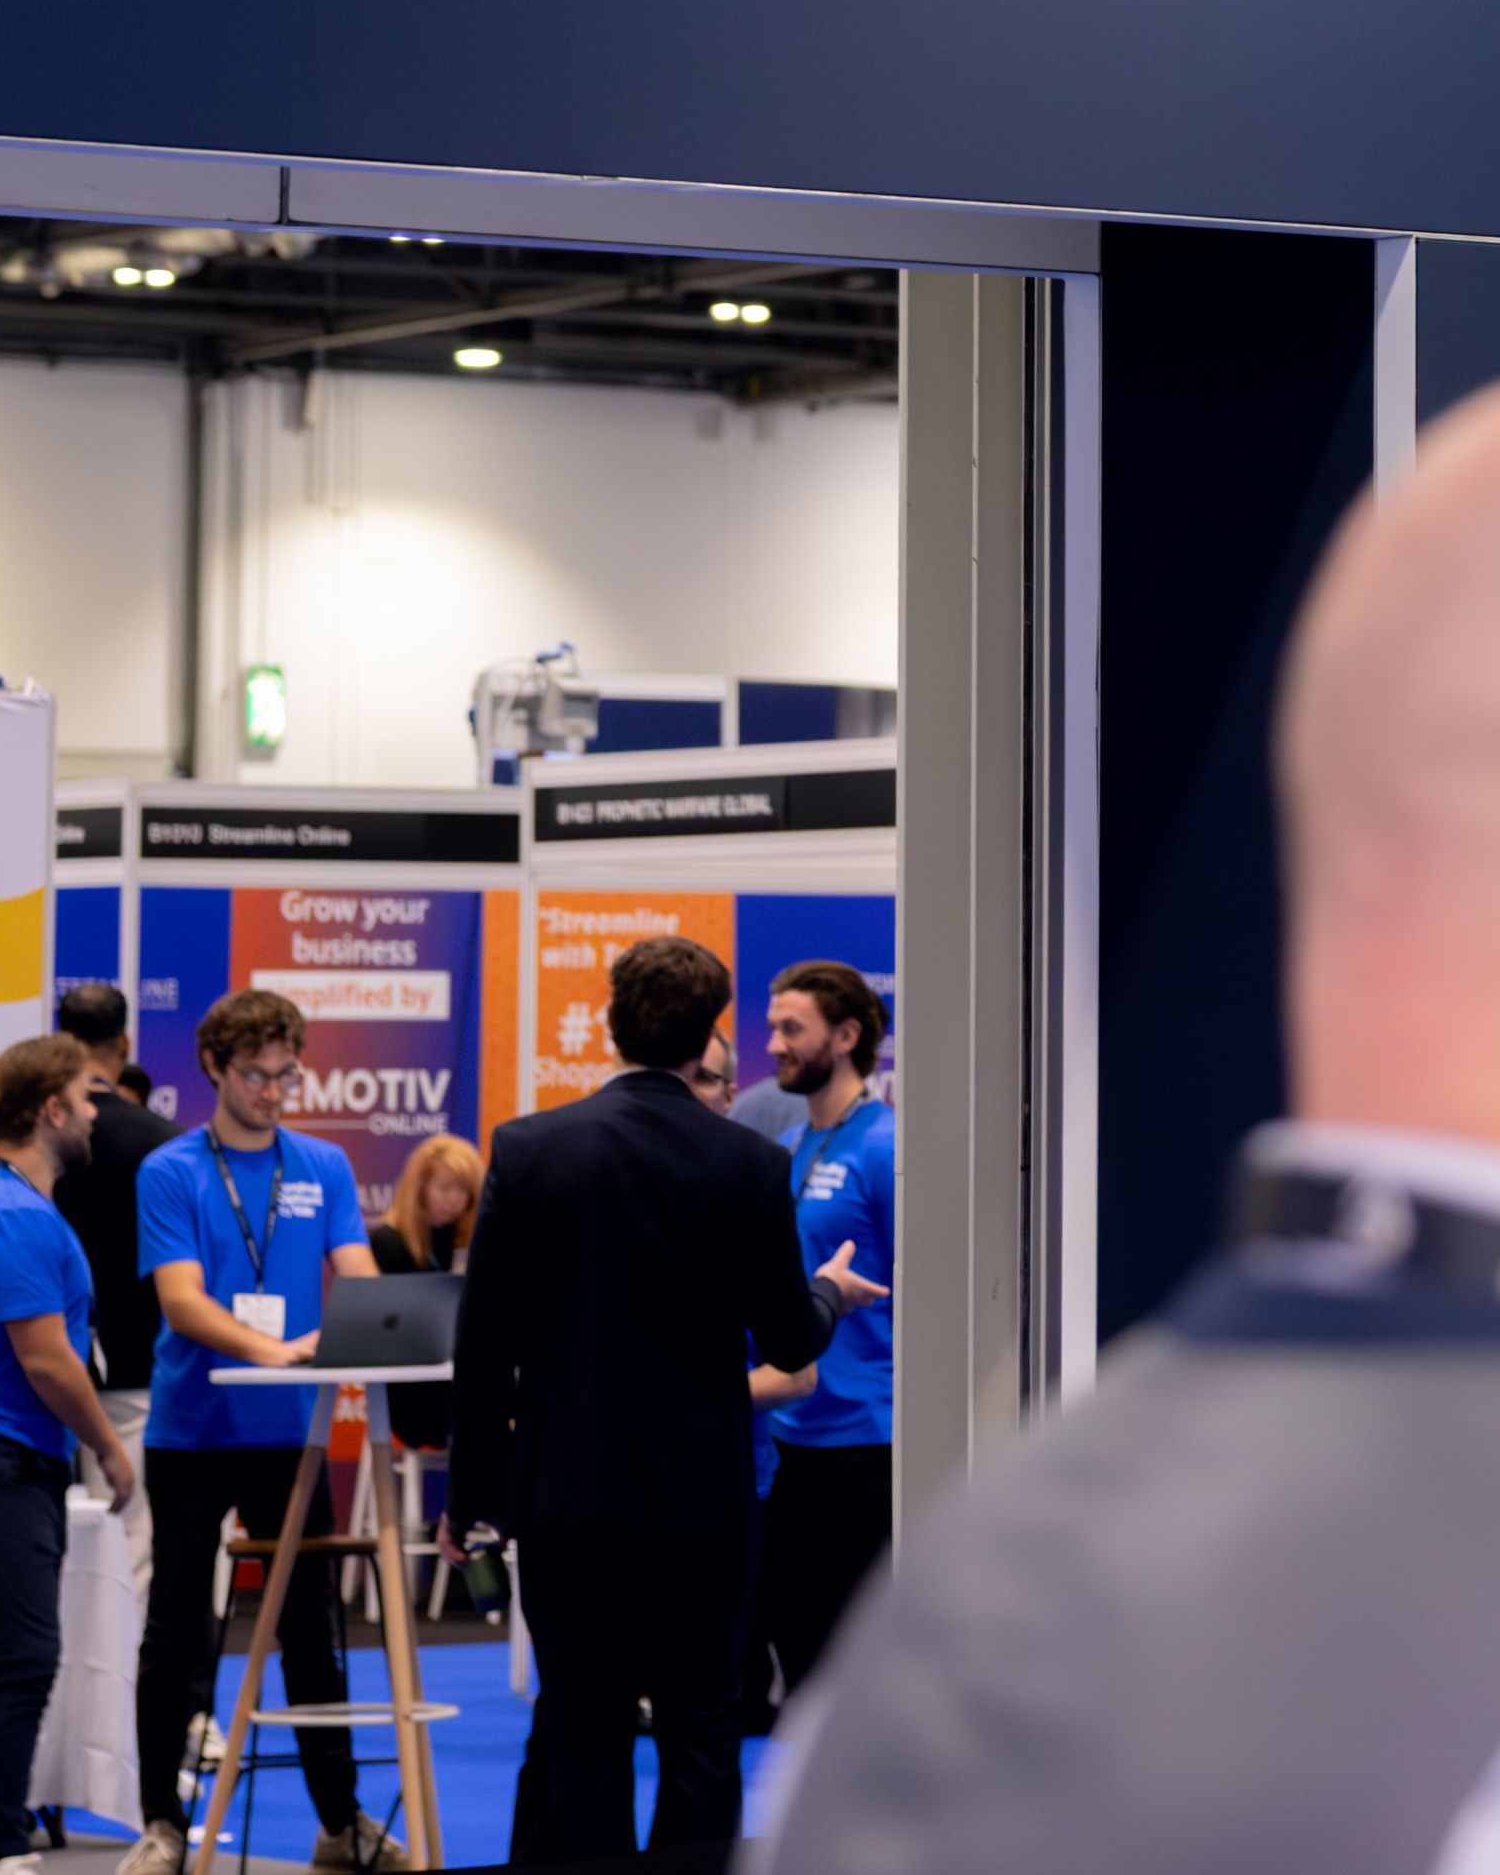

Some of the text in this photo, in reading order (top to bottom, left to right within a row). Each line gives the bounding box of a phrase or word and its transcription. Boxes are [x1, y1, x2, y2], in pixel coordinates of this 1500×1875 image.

[208, 822, 296, 846] Streamline
[298, 825, 352, 847] Online
[279, 889, 431, 932] Grow your
[290, 930, 418, 967] business
[542, 942, 598, 969] with
[402, 980, 433, 1011] by
[368, 1112, 449, 1136] ONLINE
